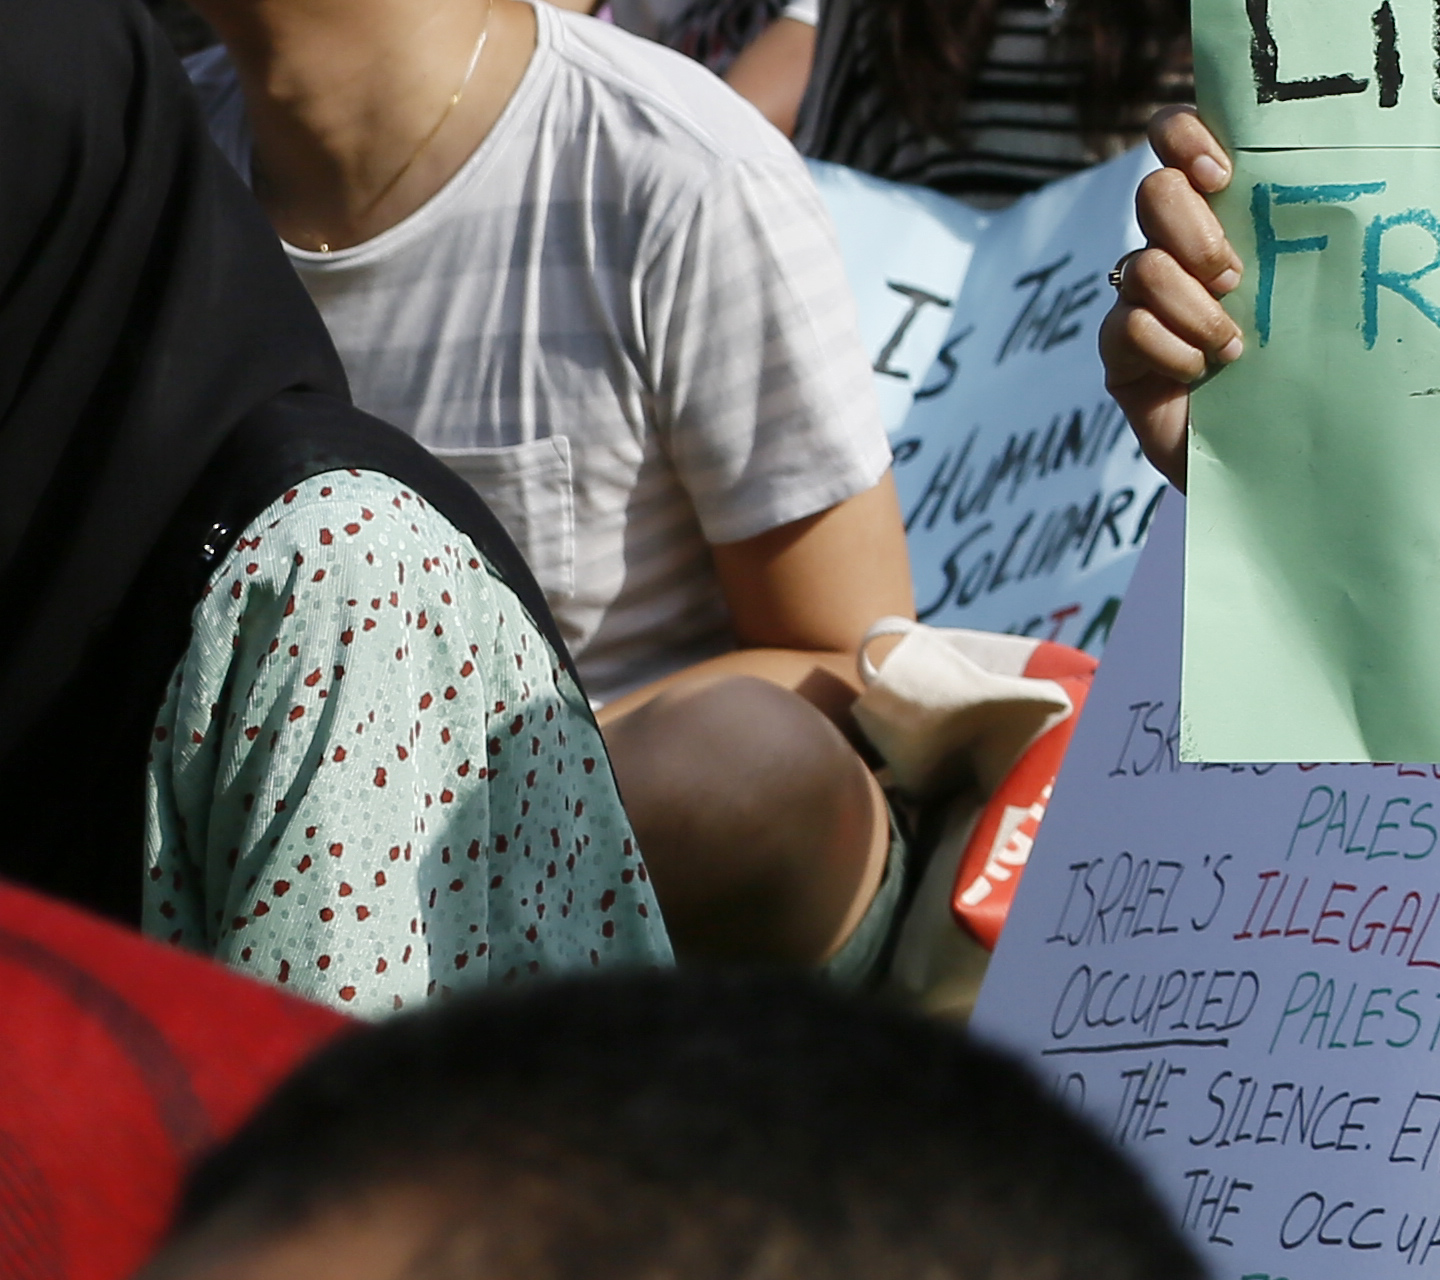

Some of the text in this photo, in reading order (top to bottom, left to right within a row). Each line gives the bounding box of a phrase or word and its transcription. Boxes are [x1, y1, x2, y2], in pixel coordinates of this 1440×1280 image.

[995, 252, 1100, 364] THE
[1046, 851, 1234, 946] ISRAEL'S
[1050, 964, 1260, 1040] OCCUPIED
[1112, 1058, 1187, 1146] THE
[1188, 1070, 1380, 1151] SILENCE.
[1181, 1168, 1254, 1247] THE
